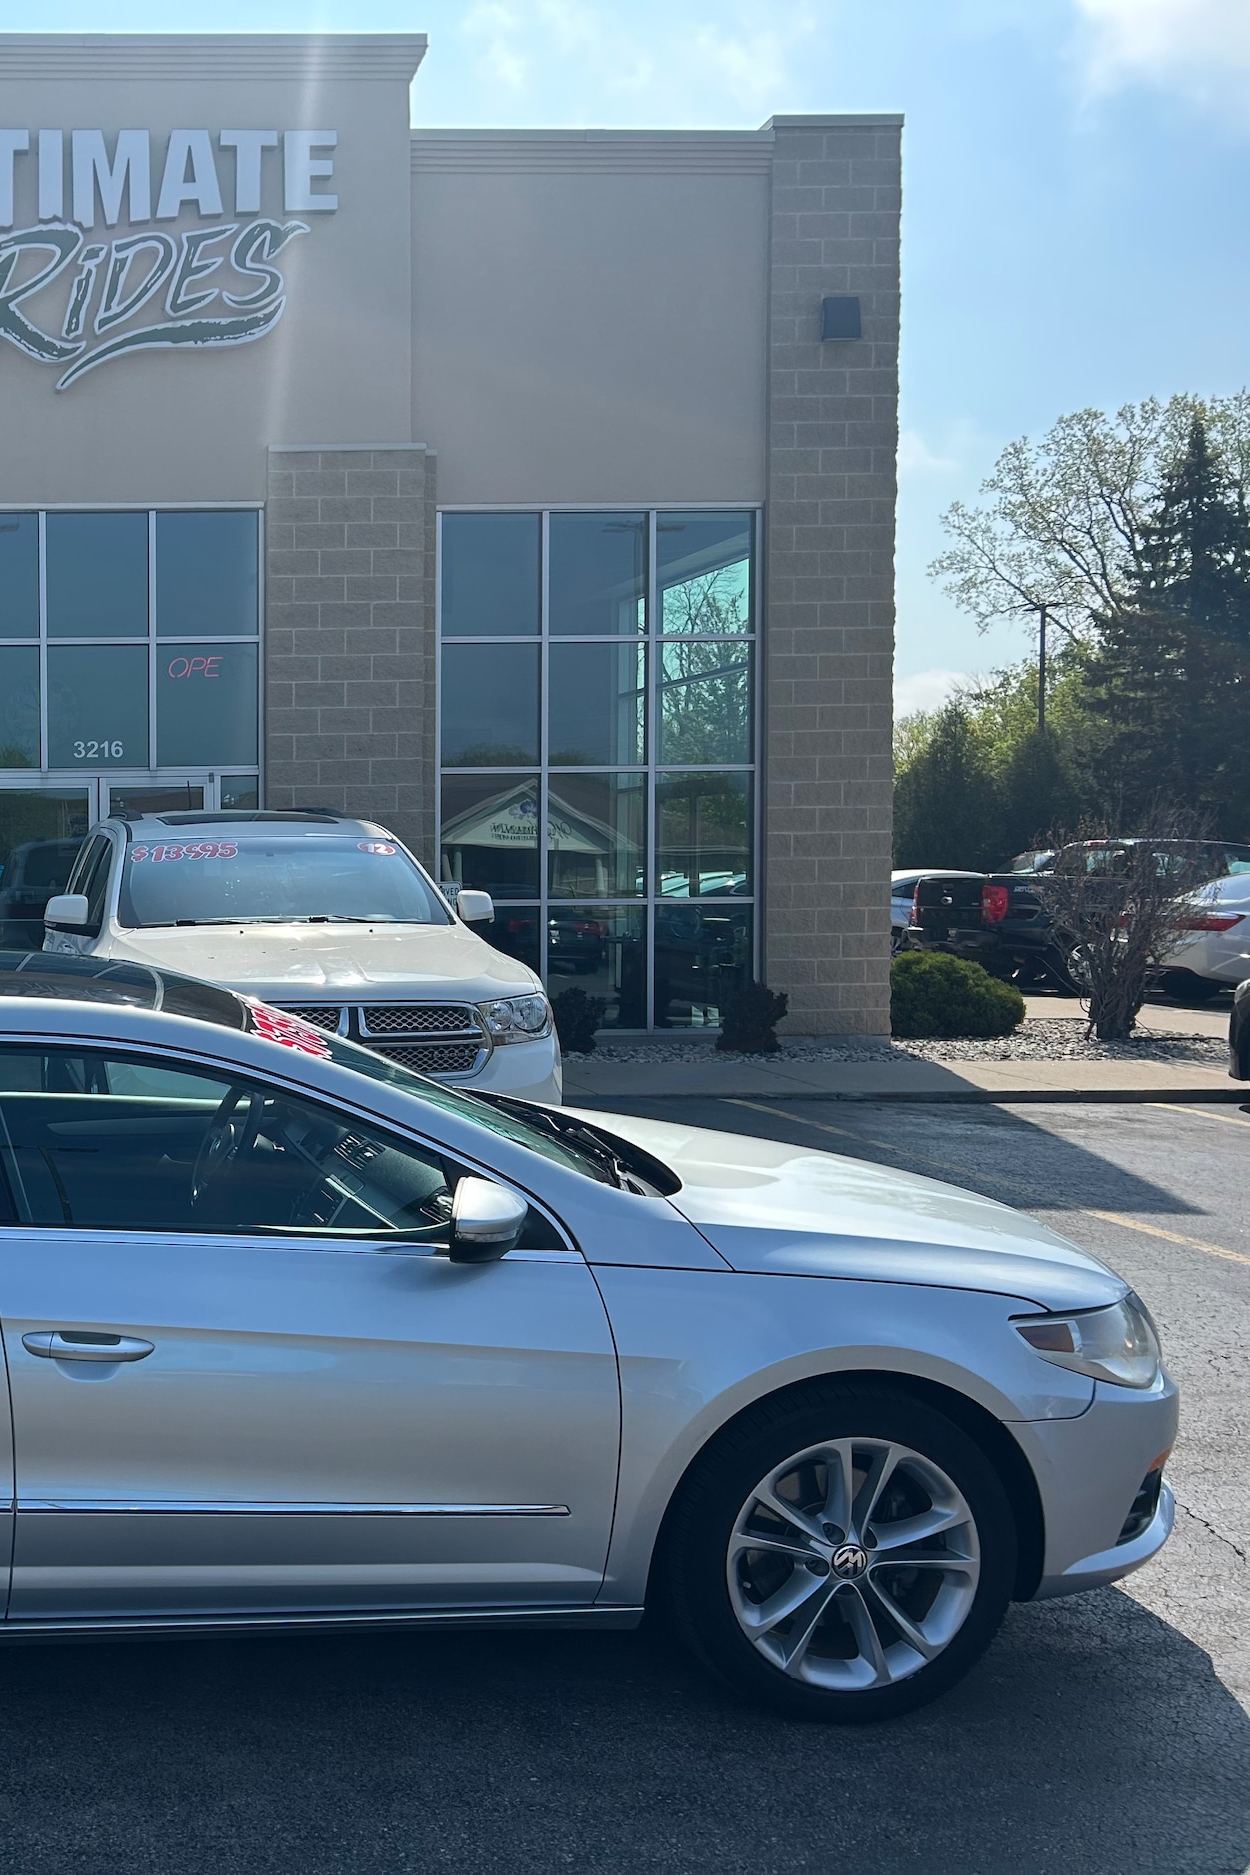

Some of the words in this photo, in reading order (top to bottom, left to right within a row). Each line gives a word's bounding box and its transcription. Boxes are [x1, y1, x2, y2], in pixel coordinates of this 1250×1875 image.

[73, 740, 123, 758] 3216
[131, 842, 238, 862] $13995
[365, 843, 389, 854] 12
